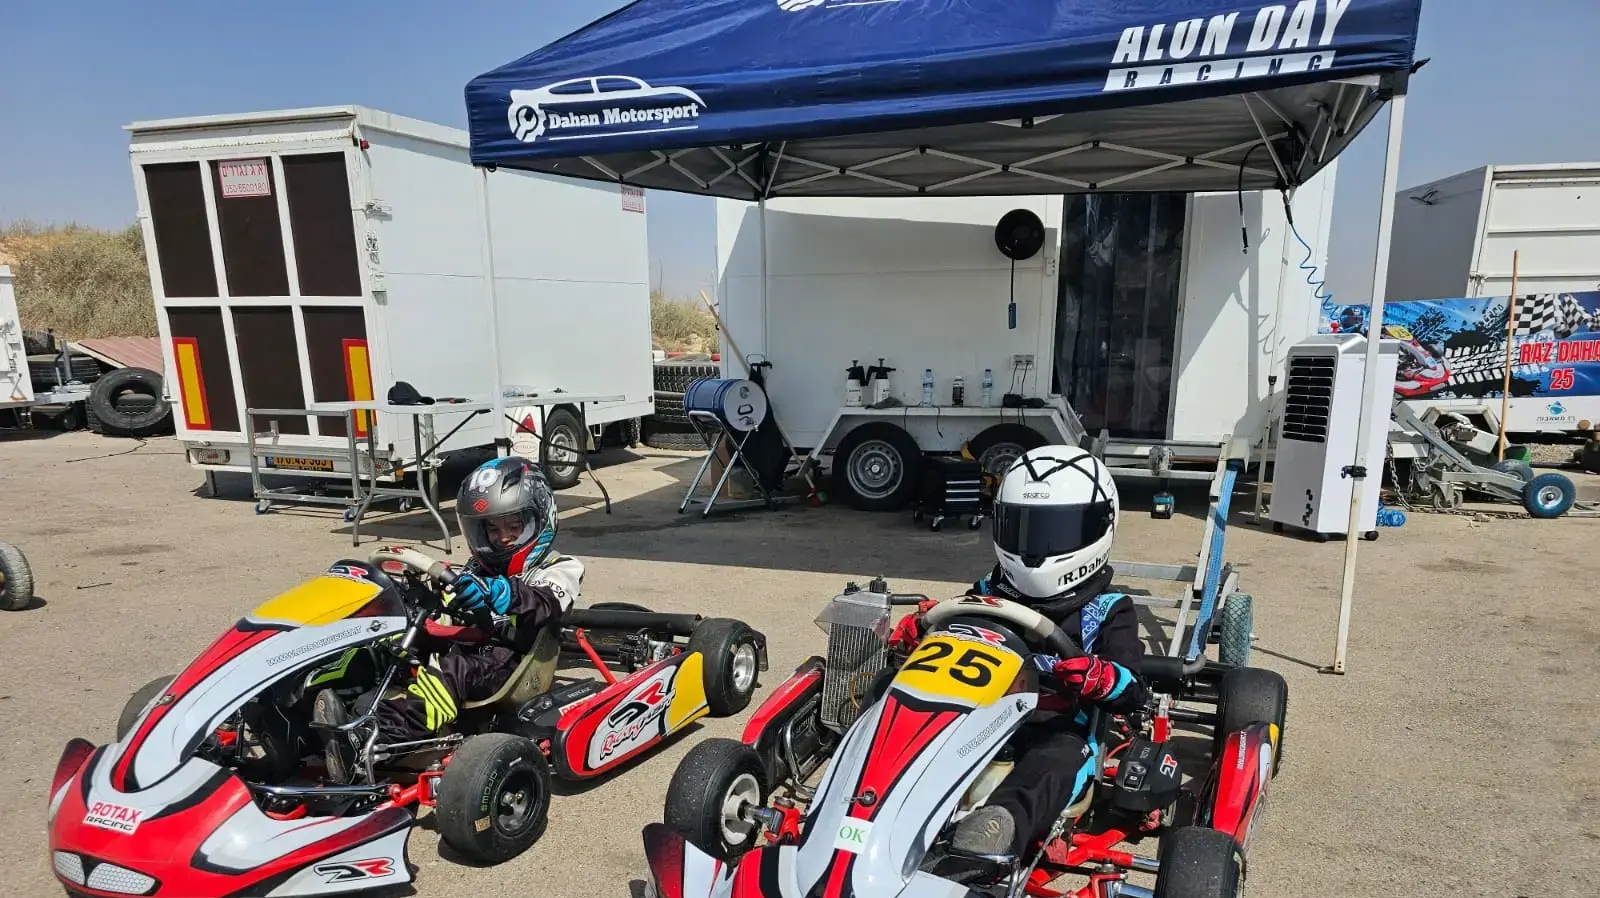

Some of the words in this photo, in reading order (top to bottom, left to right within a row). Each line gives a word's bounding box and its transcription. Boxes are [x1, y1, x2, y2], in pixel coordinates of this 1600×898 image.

[1246, 0, 1350, 52] DAY
[1123, 54, 1323, 88] RACING
[548, 112, 600, 129] Dahan
[602, 102, 699, 125] Motorsport
[1520, 341, 1553, 364] RAZ
[1549, 367, 1575, 390] 25
[903, 640, 1003, 689] 25
[86, 815, 134, 831] RACING
[90, 802, 142, 824] ROTAX
[840, 825, 866, 843] OK
